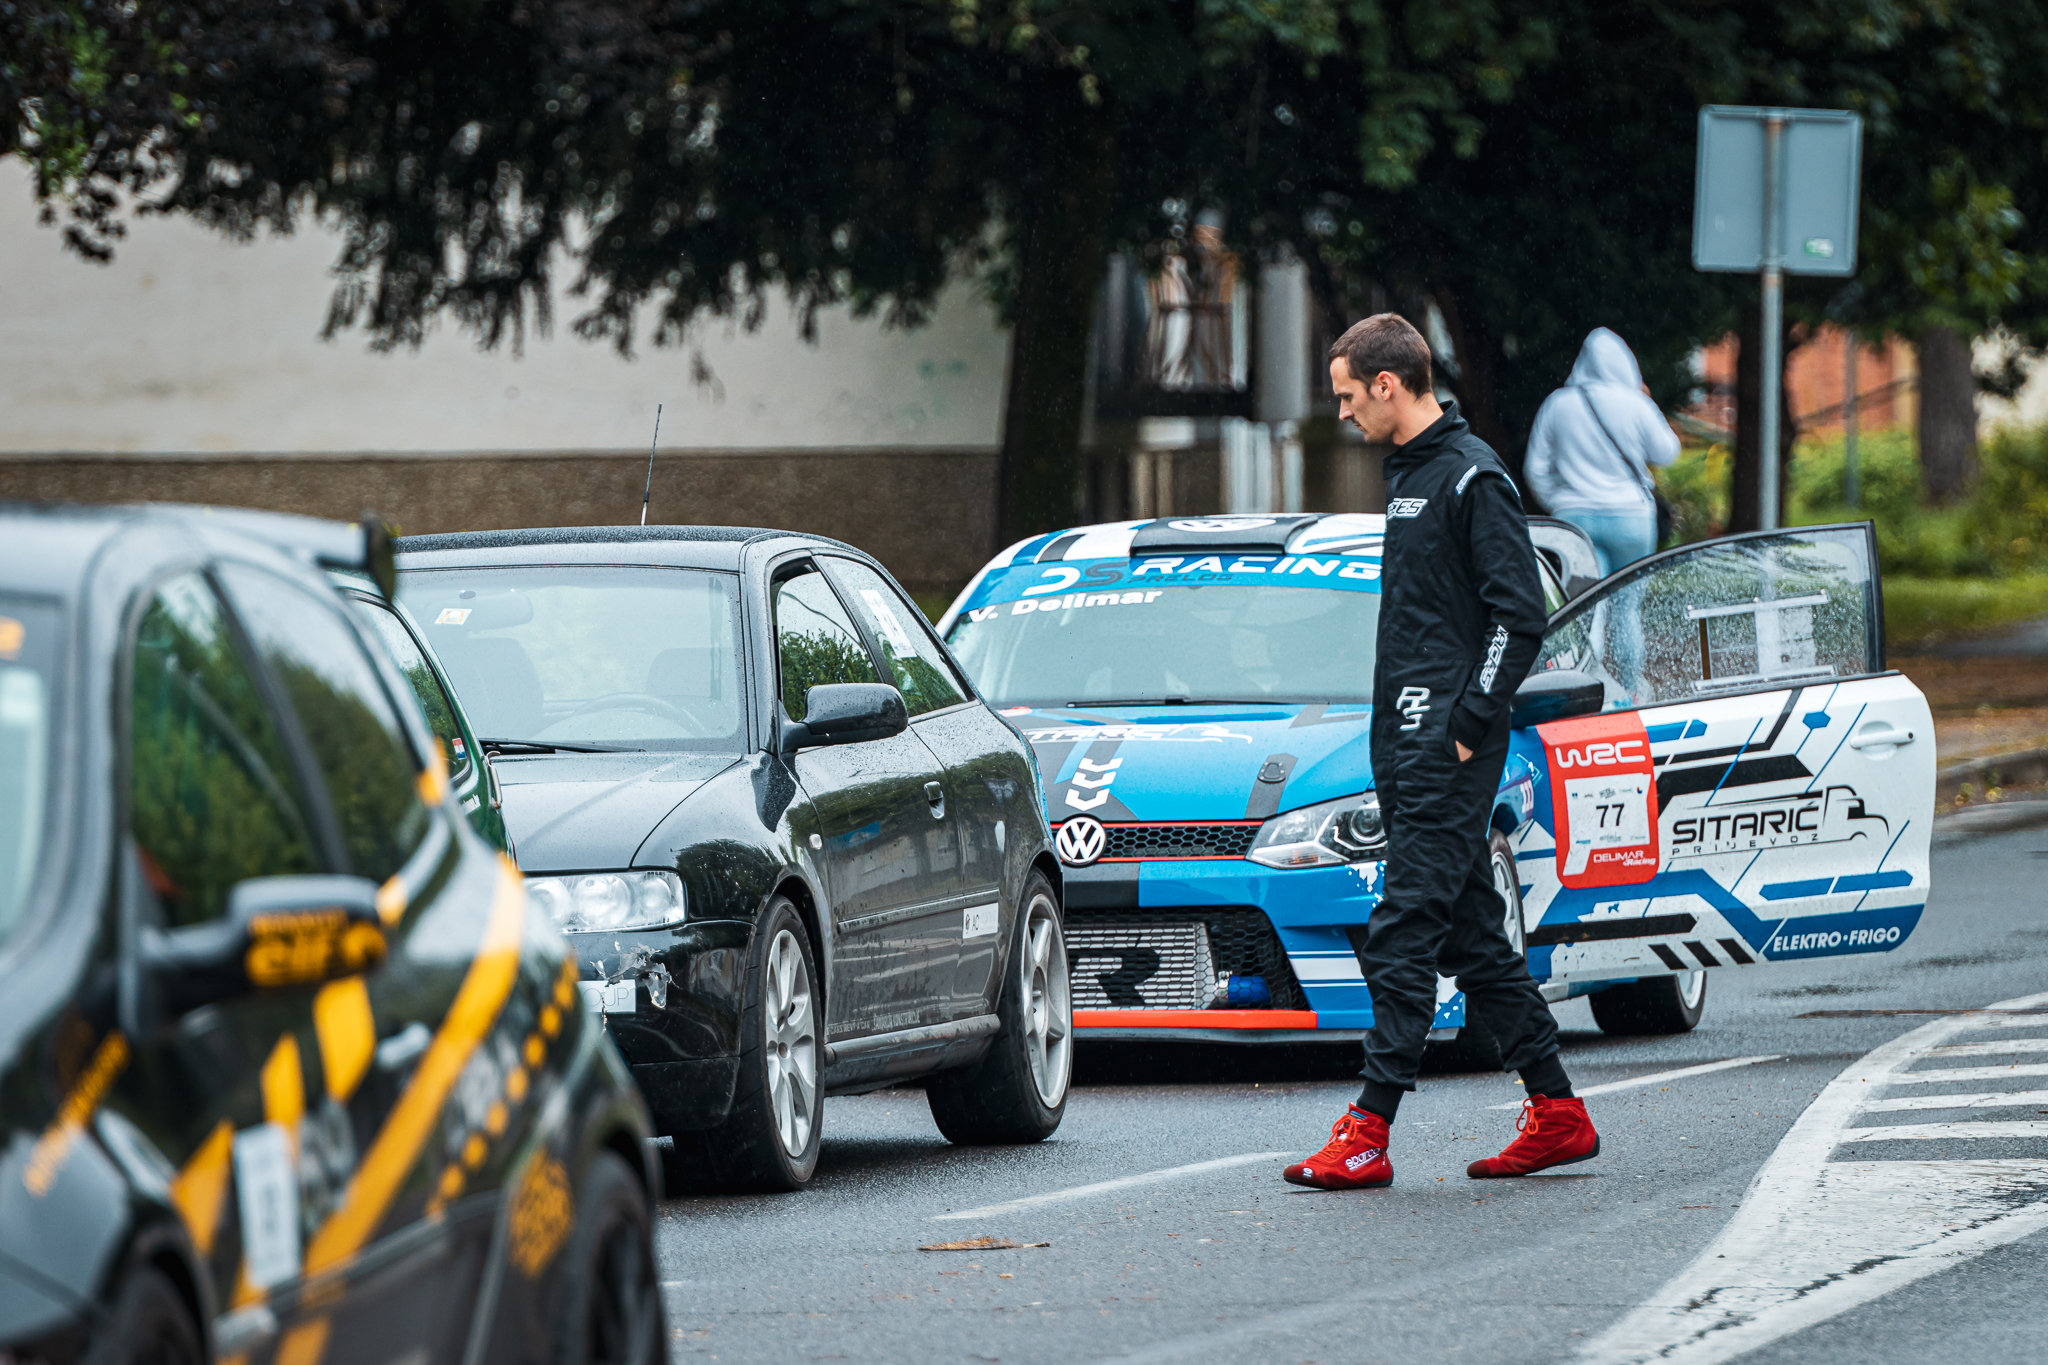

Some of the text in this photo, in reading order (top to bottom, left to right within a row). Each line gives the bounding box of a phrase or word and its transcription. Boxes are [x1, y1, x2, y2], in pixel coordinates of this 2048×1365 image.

[1132, 556, 1382, 580] RACING
[968, 605, 999, 623] V.
[1555, 740, 1646, 769] WRC
[1596, 803, 1625, 828] 77
[1672, 801, 1819, 845] SITARIĆ
[1672, 833, 1819, 856] PRIJEVOZ
[1593, 850, 1644, 863] DELIMAR
[1345, 1148, 1381, 1171] sparco
